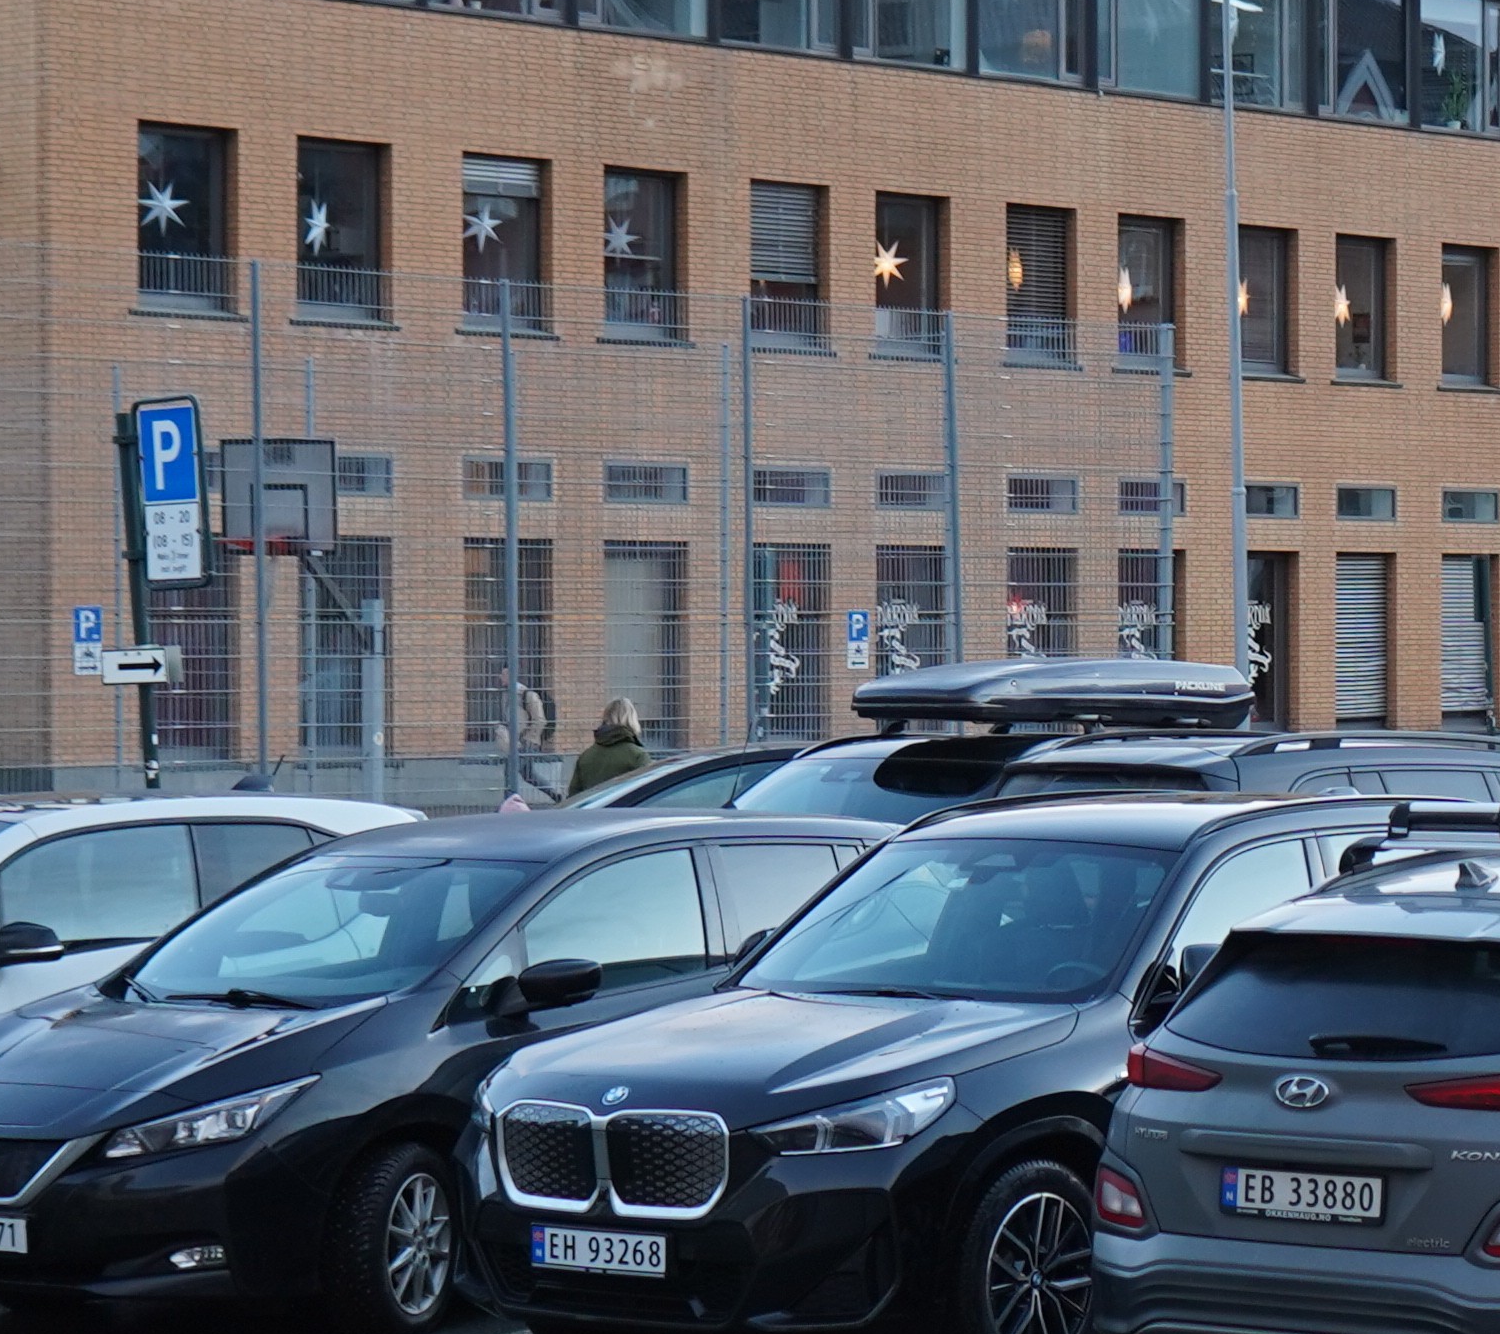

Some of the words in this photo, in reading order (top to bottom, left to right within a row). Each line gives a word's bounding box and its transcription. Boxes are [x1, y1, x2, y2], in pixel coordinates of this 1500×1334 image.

[151, 419, 181, 491] P
[179, 510, 190, 523] 20
[79, 610, 96, 639] P
[851, 614, 864, 638] P
[1244, 1173, 1275, 1204] EB
[1288, 1177, 1374, 1212] 33880
[550, 1233, 576, 1260] EH
[588, 1237, 661, 1267] 93268
[1406, 1237, 1451, 1248] electric
